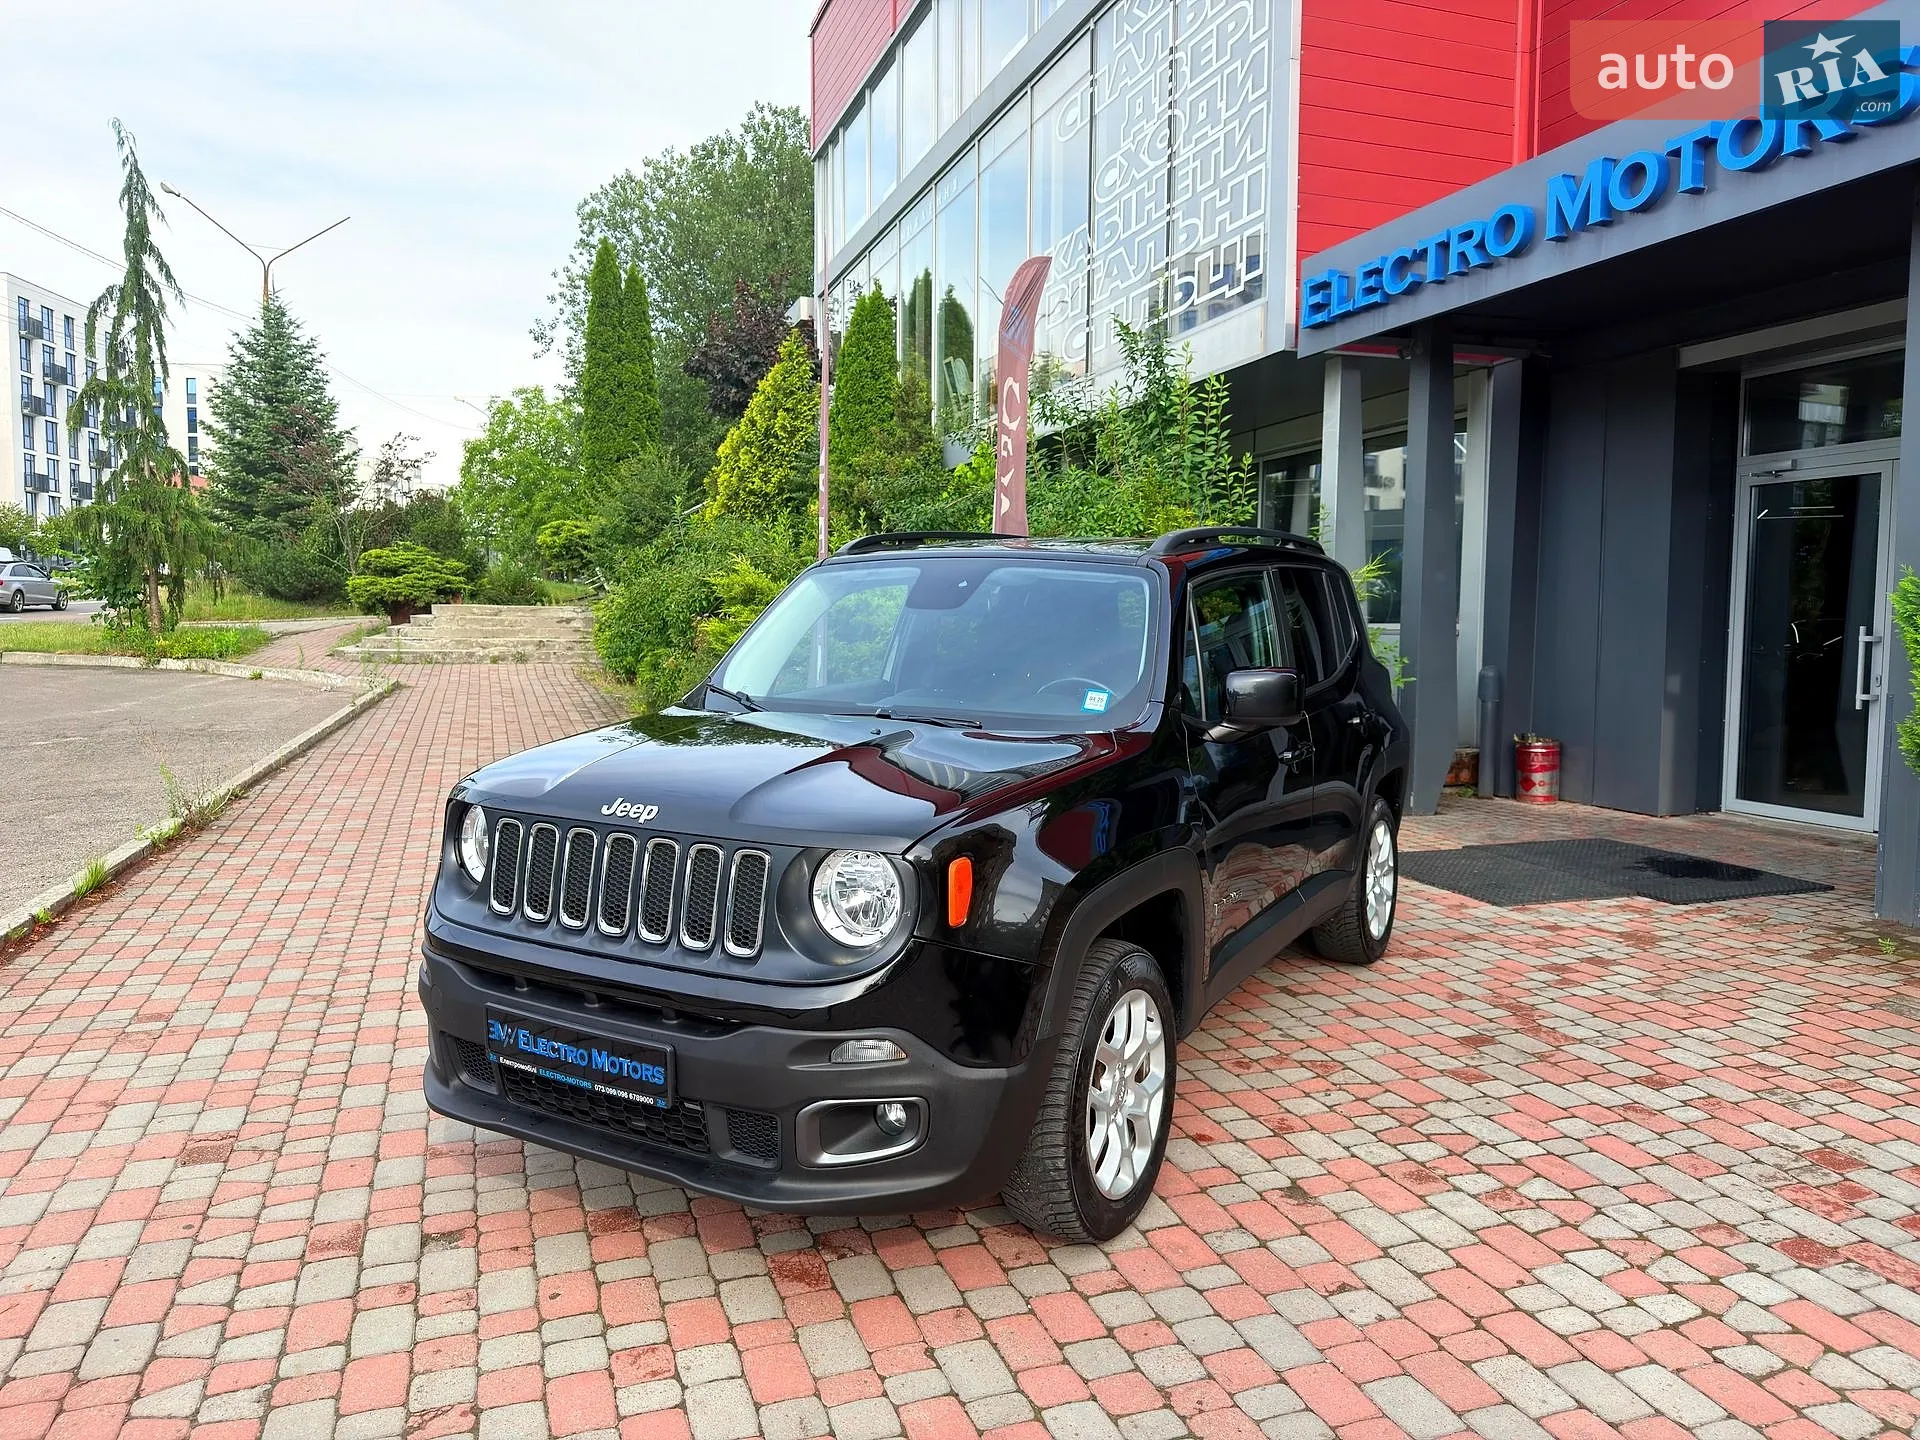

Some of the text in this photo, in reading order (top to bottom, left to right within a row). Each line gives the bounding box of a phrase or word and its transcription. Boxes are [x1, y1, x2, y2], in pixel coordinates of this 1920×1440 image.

[1044, 101, 1268, 284] КАБІНЕТИ
[1094, 38, 1269, 203] СХОДИ
[1302, 45, 1920, 330] ELECTRO MOTORS
[1045, 161, 1267, 331] ВІТАЛЬНІ
[601, 797, 659, 825] Jeep
[518, 1029, 588, 1067] ELECTRO
[591, 1048, 665, 1085] MOTORS
